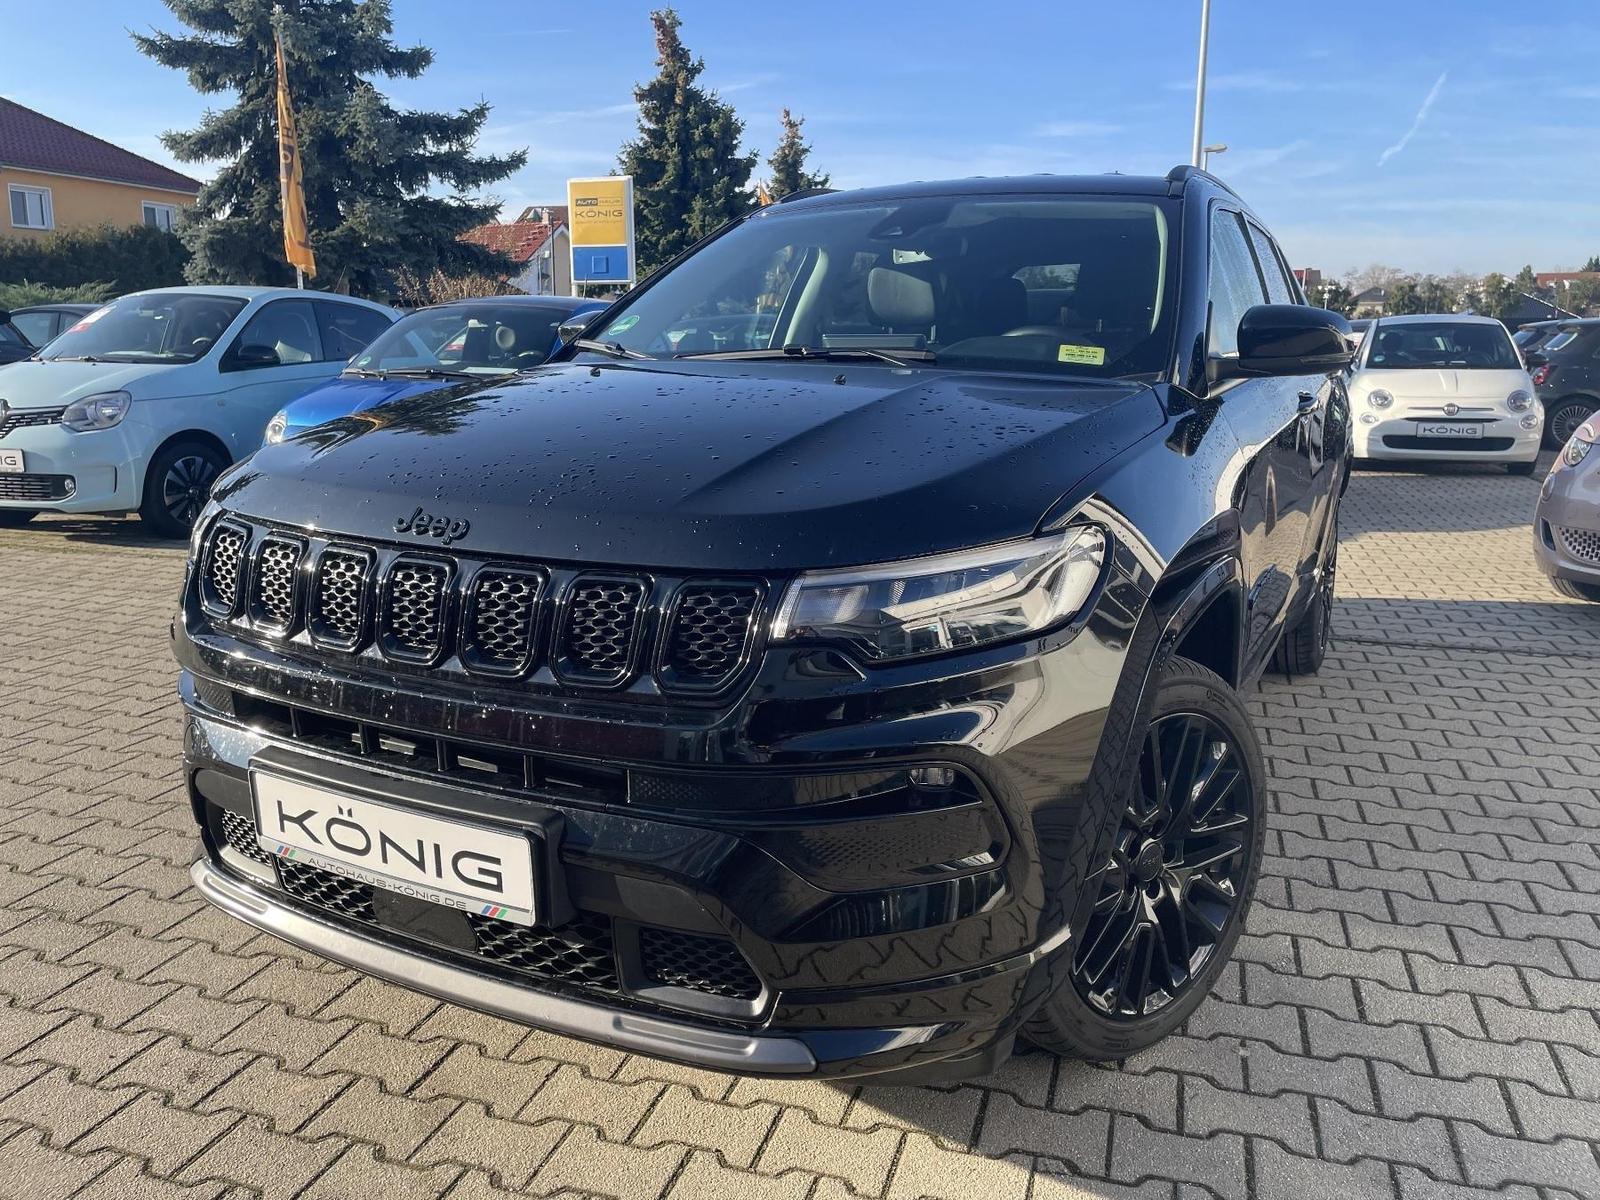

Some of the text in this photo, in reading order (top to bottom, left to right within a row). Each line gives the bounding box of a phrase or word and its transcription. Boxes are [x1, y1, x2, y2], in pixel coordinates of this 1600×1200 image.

[575, 208, 623, 218] KÖNIG
[1423, 425, 1477, 435] KÖNIG
[393, 506, 471, 545] Jeep
[277, 800, 503, 893] KÖNIG
[308, 857, 468, 910] AUTOHAUS-KÖNIG.DE
